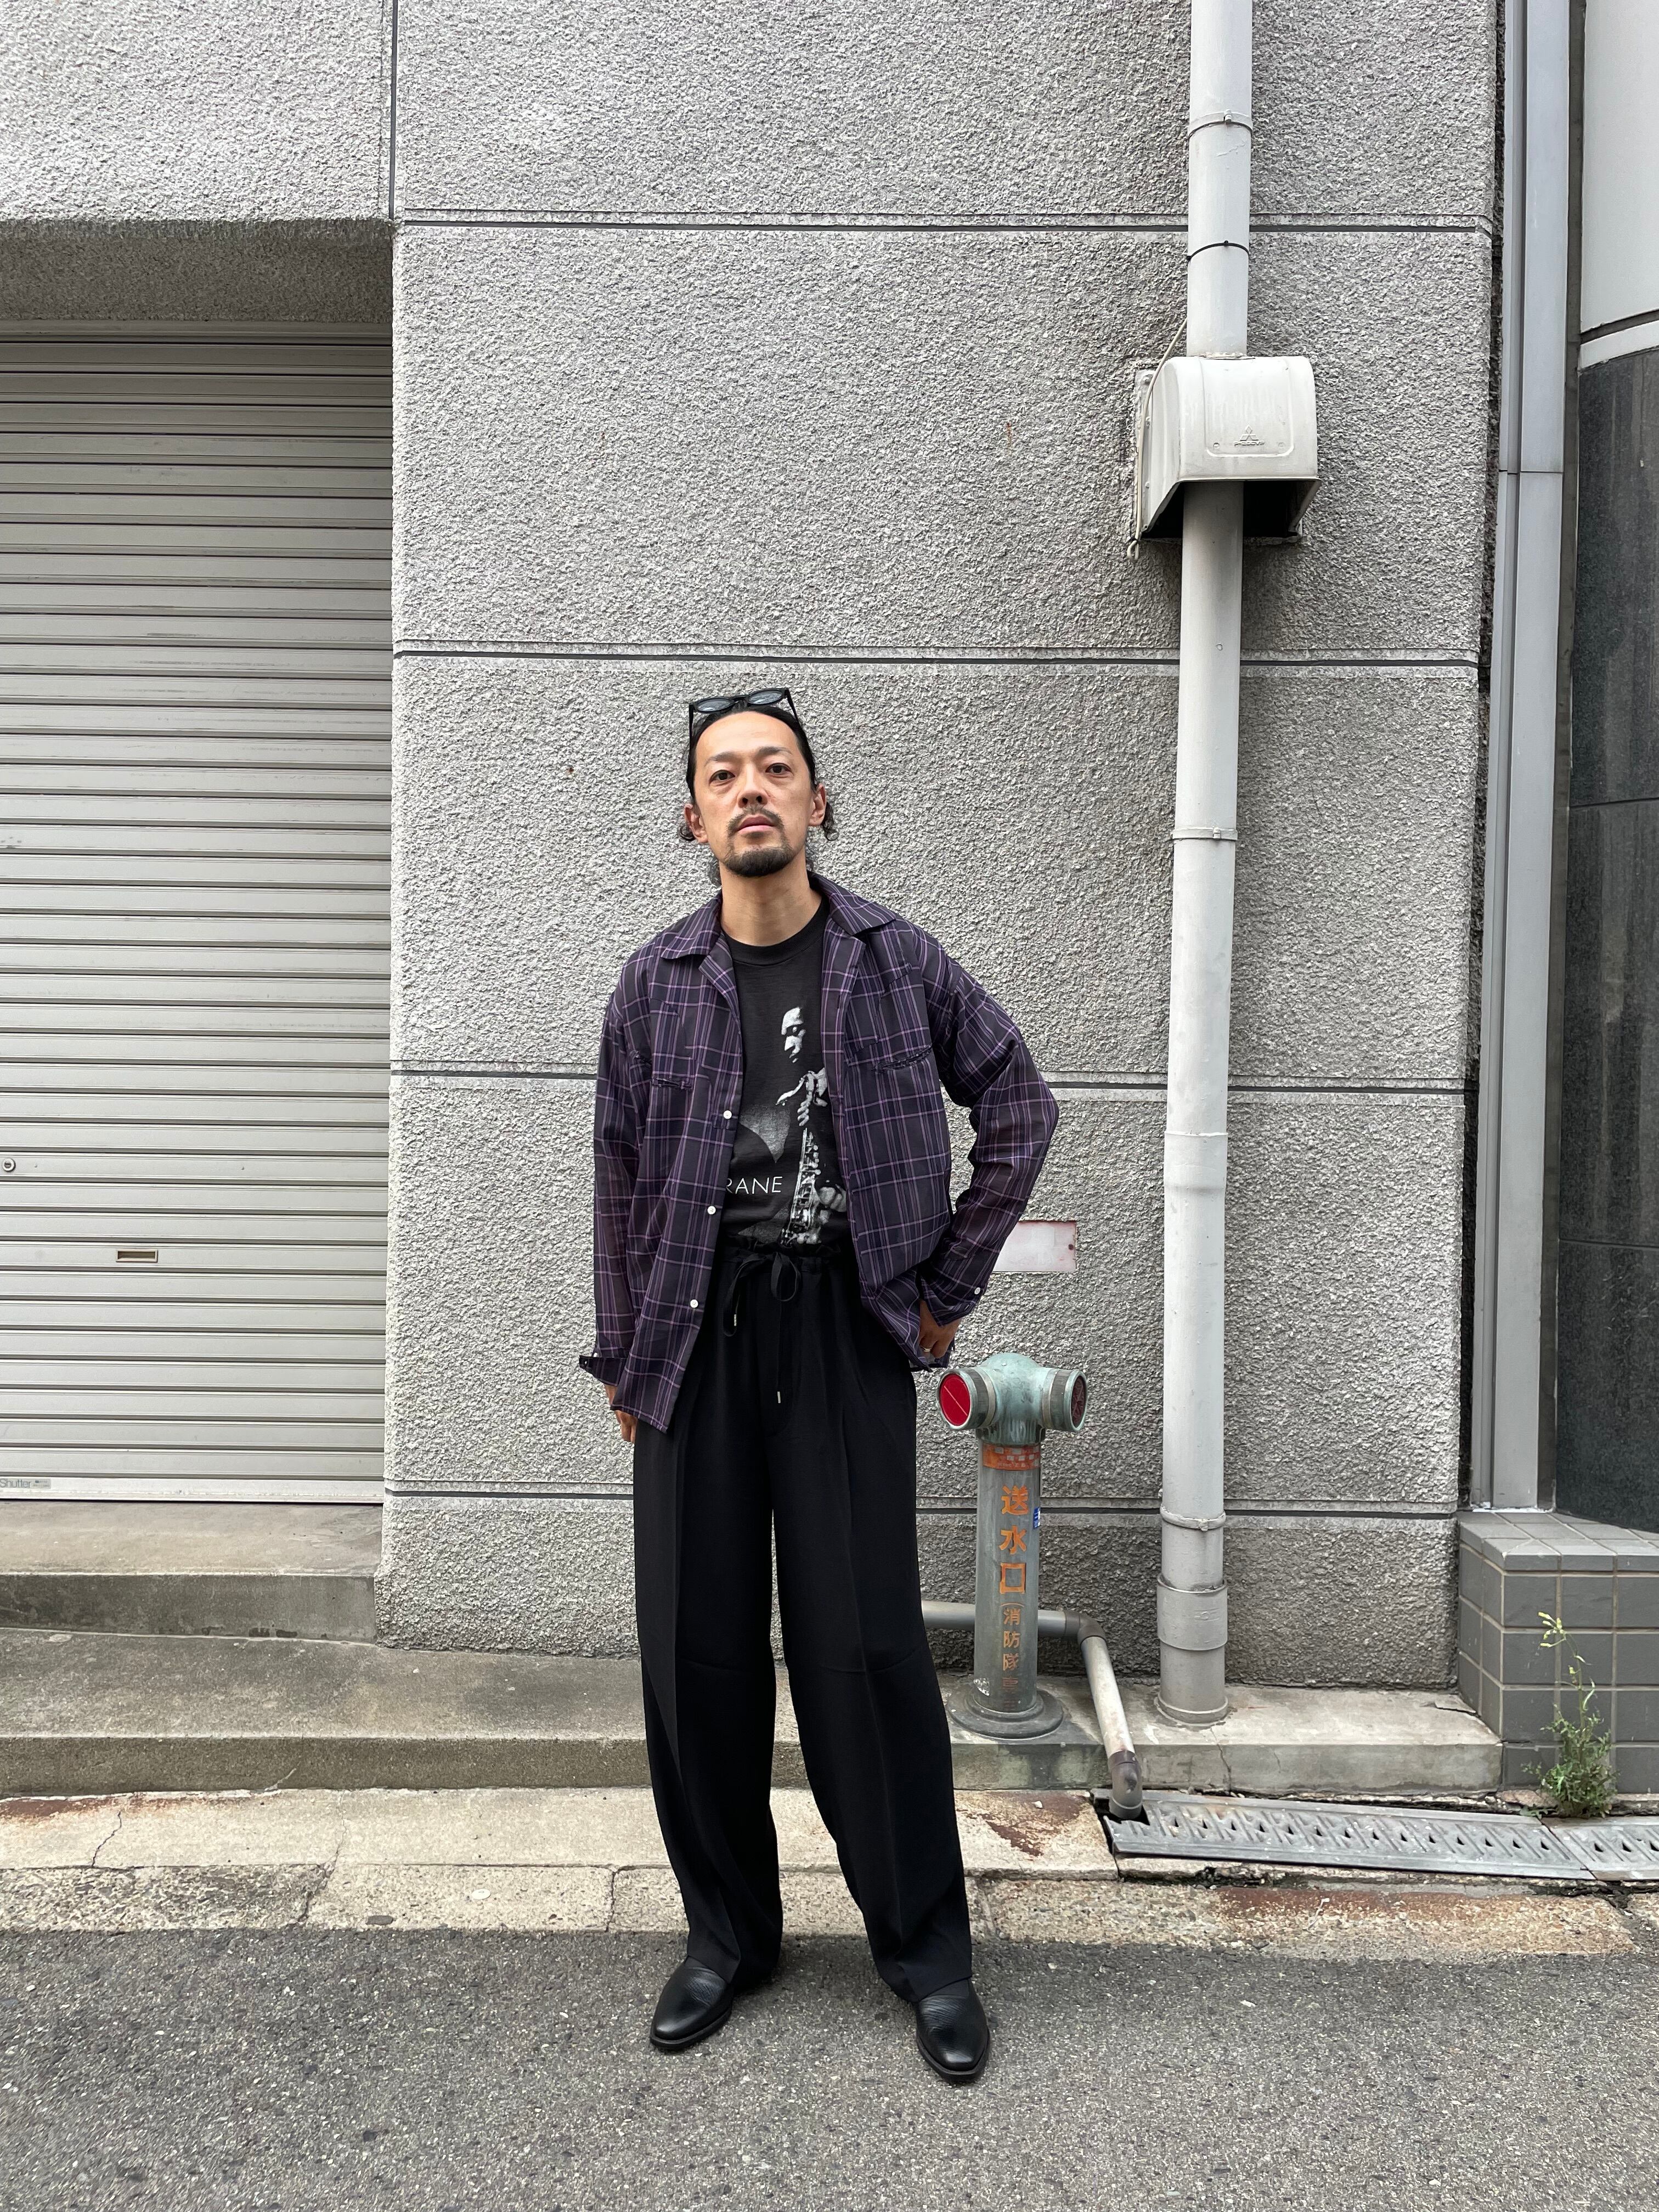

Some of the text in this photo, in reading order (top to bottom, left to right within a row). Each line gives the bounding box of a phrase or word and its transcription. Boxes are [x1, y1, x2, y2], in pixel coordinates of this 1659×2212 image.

[726, 1176, 783, 1194] RANE
[0, 1479, 31, 1488] Shutter
[998, 1485, 1029, 1594] 送水口
